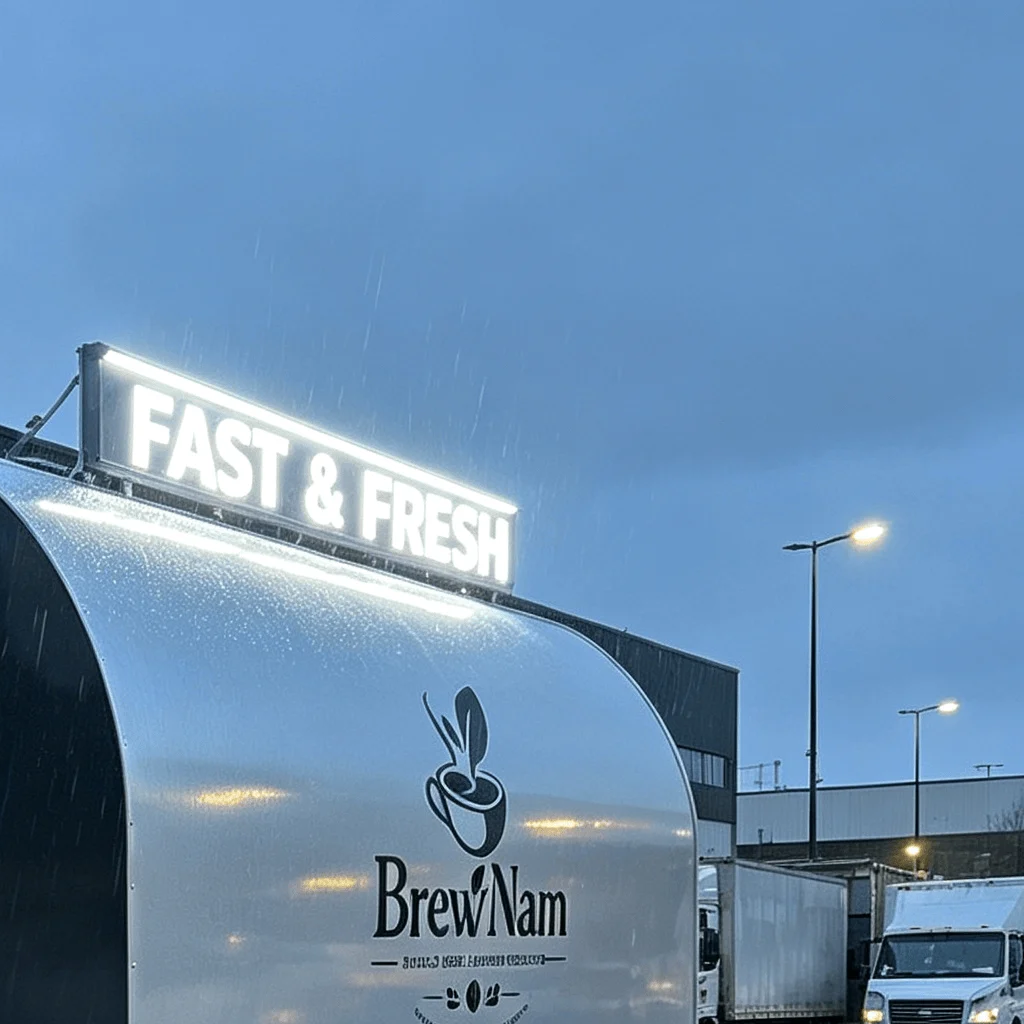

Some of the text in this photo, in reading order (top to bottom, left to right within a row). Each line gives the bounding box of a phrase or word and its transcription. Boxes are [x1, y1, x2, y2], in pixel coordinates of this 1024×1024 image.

[130, 384, 511, 583] FAST & FRESH
